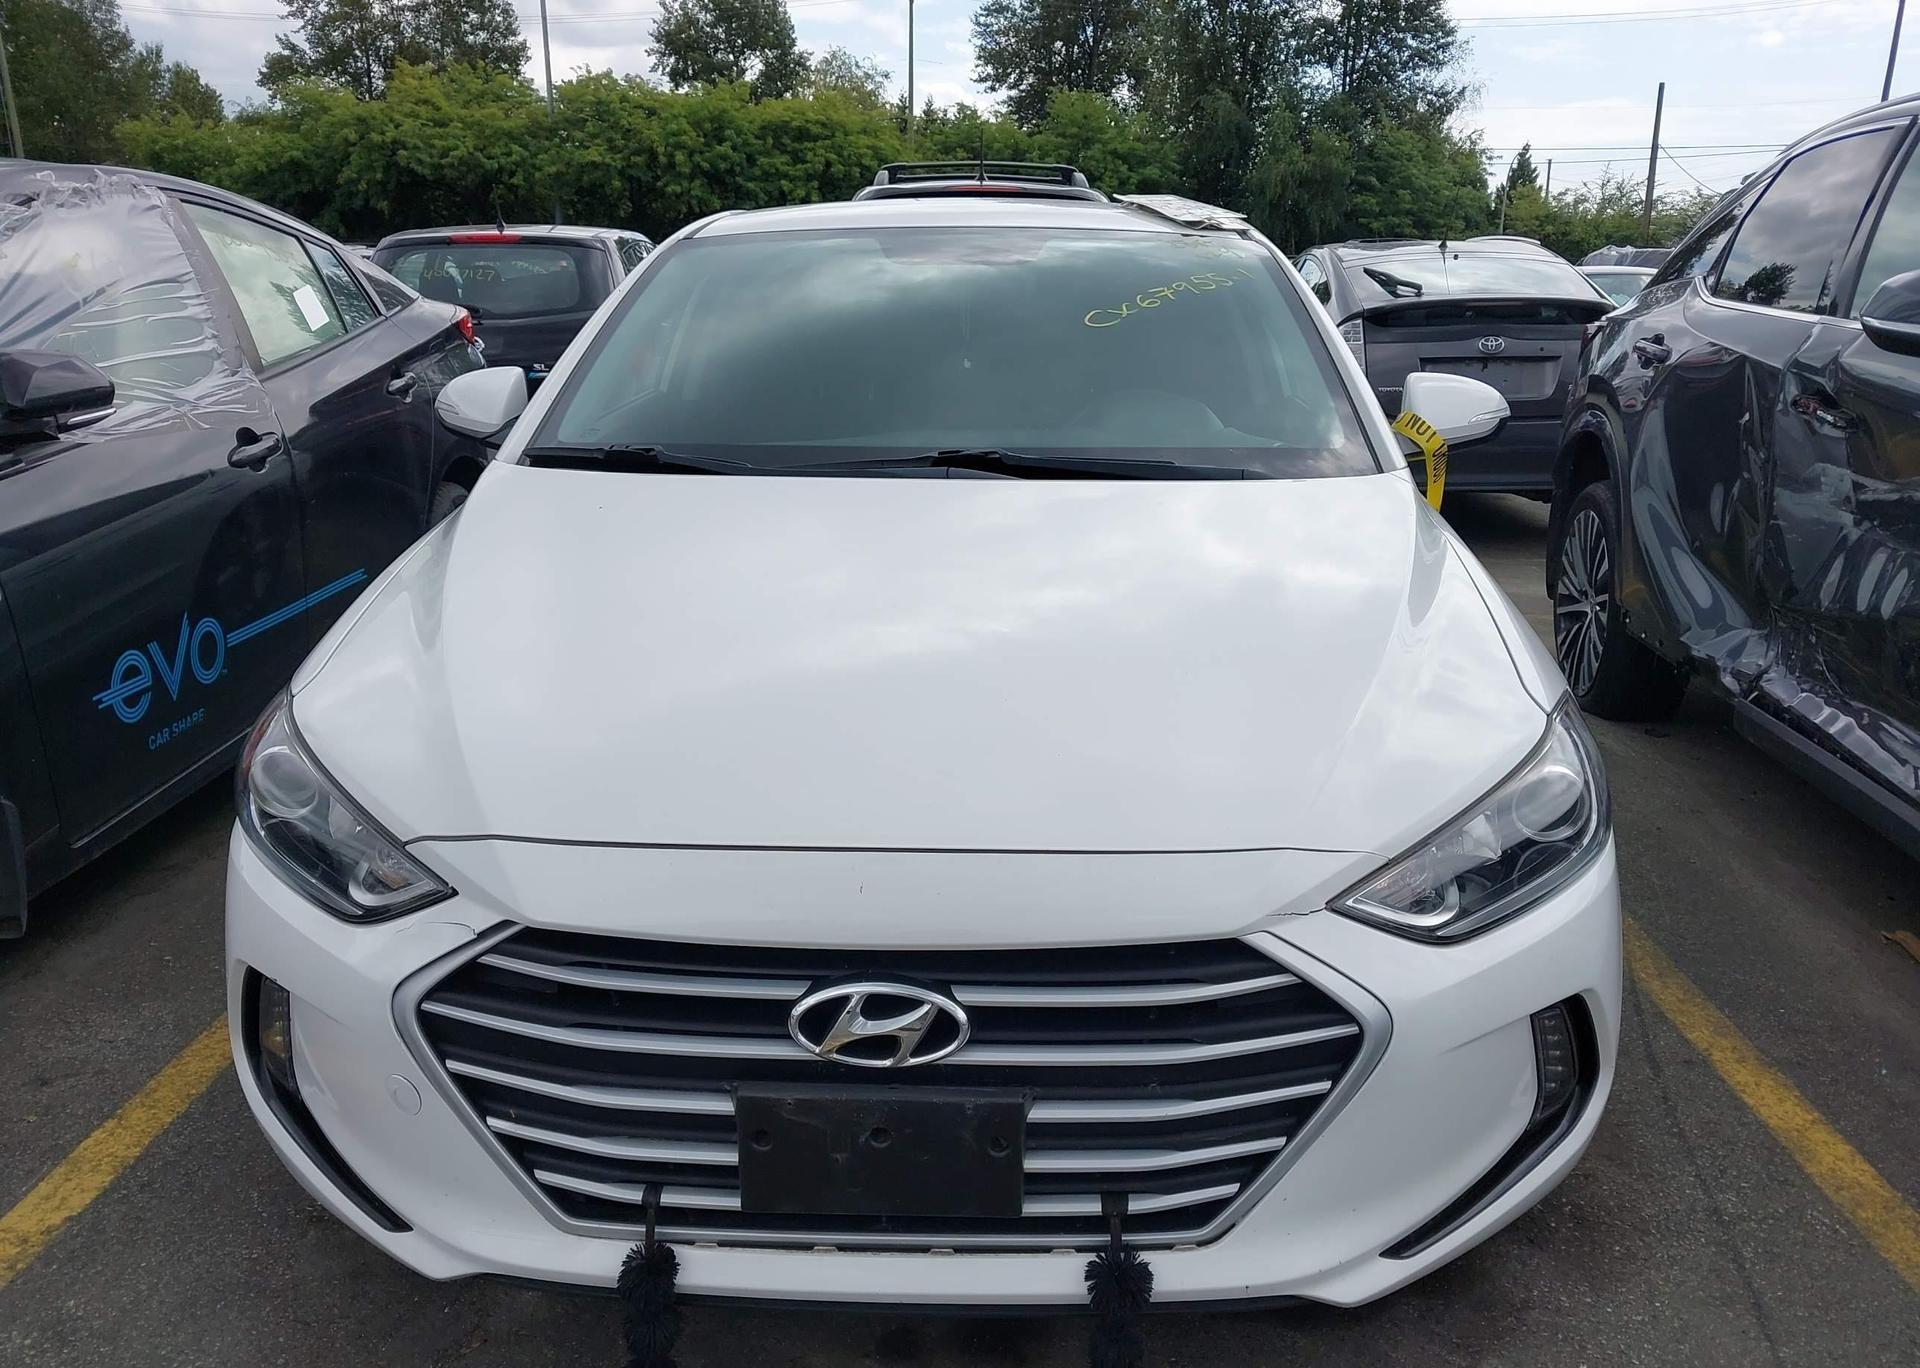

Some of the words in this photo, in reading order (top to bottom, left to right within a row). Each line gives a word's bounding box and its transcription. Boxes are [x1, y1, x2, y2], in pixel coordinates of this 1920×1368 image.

[533, 363, 550, 371] SL
[148, 727, 171, 751] CAR
[171, 707, 207, 738] SHARE
